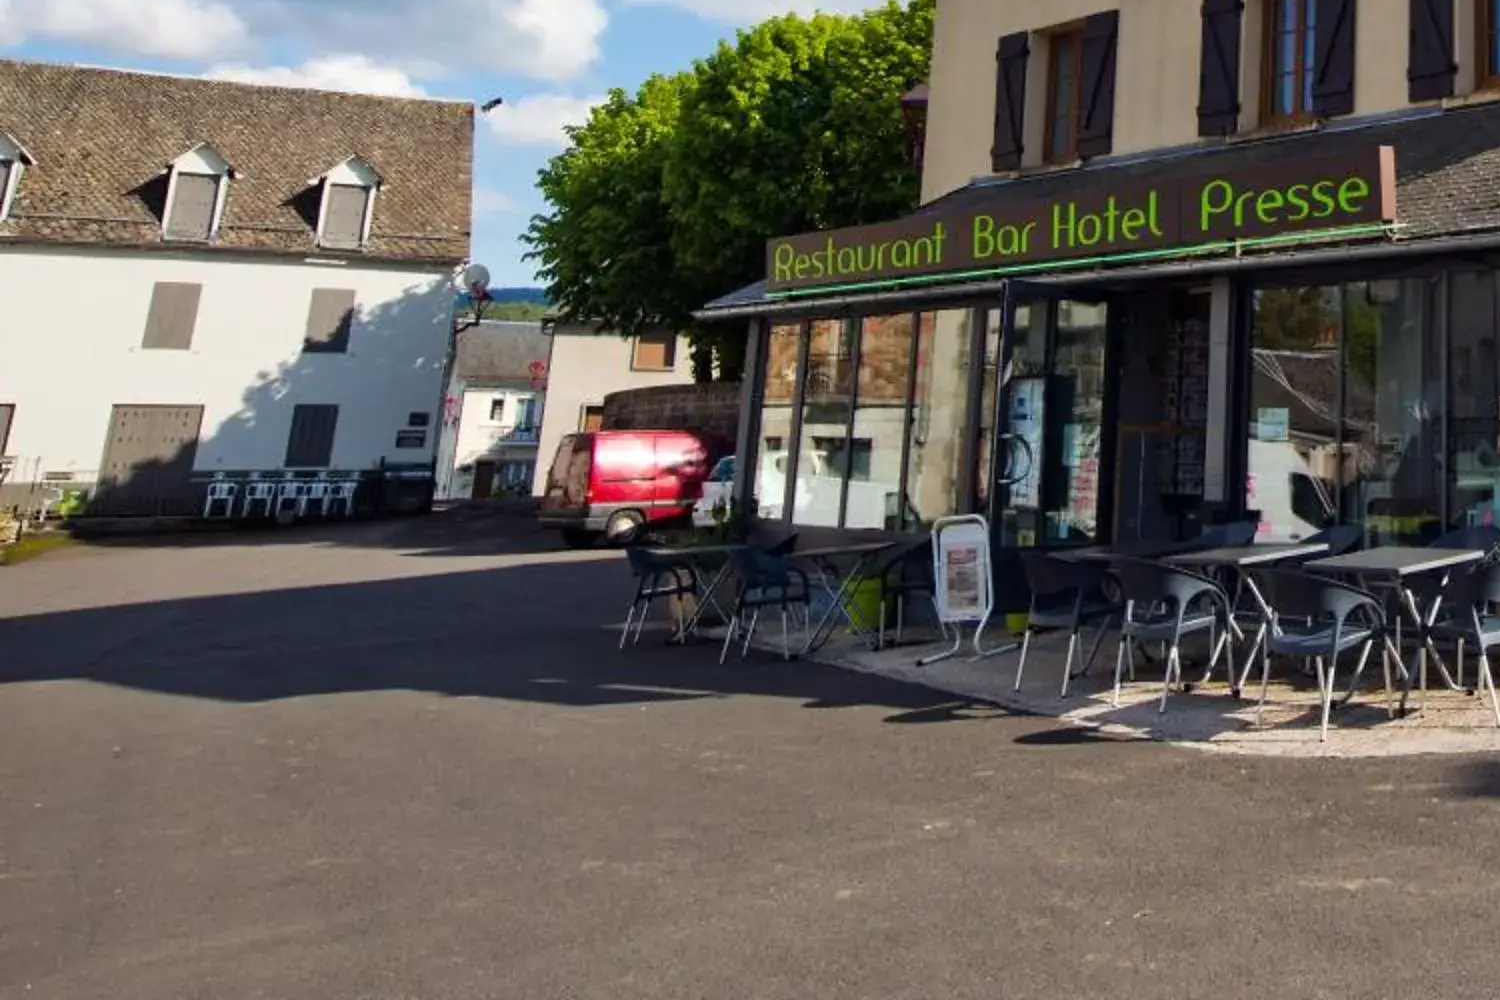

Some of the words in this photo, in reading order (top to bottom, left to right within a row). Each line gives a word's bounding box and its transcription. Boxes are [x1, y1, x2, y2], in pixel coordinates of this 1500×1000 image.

[774, 220, 946, 282] Restaurant
[973, 214, 1036, 259] Bar
[1052, 188, 1164, 249] Hotel
[1201, 175, 1370, 231] Presse
